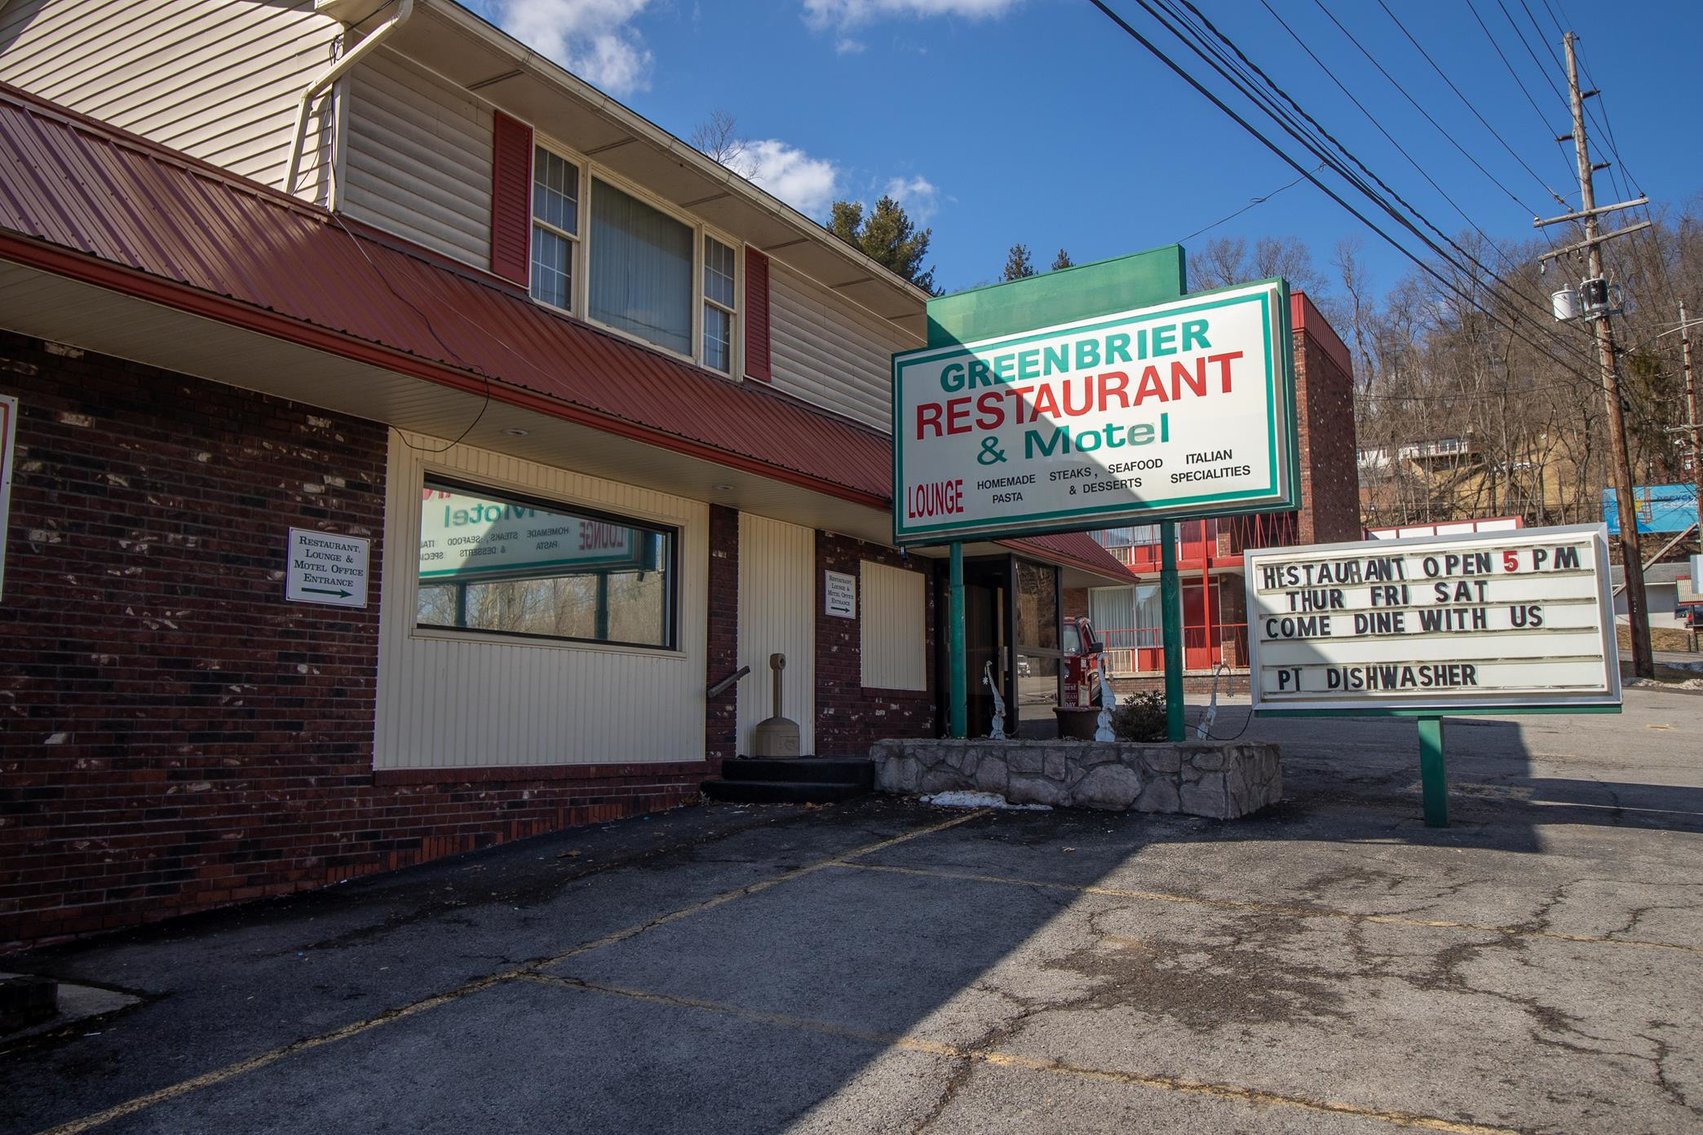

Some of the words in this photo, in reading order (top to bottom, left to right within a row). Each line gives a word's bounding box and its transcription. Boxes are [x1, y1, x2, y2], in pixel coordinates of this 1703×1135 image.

[940, 319, 1212, 392] GREENBRIER
[916, 351, 1244, 440] RESTAURANT
[976, 435, 1007, 466] &
[1025, 412, 1169, 460] Motel
[1108, 458, 1164, 474] SEAFOOD
[1185, 449, 1233, 464] ITALIAN
[977, 473, 1036, 490] HOMEMADE
[1170, 465, 1251, 484] SPECIALITIES
[1069, 485, 1077, 495] &
[1083, 477, 1142, 493] DESSERTS
[908, 479, 964, 519] LOUNGE
[992, 492, 1023, 504] PASTA
[305, 549, 341, 562] LOUNGE
[345, 555, 354, 564] &
[1423, 552, 1491, 578] OPEN
[1503, 550, 1519, 572] 5
[1532, 546, 1579, 570] PM
[294, 560, 327, 572] MOTEL
[331, 564, 363, 577] OFFICE
[303, 573, 354, 587] ENTRANCE
[1286, 588, 1344, 611] THUR
[1369, 584, 1408, 606] FRI
[1434, 580, 1487, 602] SAT
[1266, 615, 1331, 638] COME
[1354, 612, 1405, 634] DINE
[1419, 607, 1487, 631] WITH
[1510, 605, 1543, 627] US
[1278, 668, 1302, 691] PT
[1327, 664, 1477, 691] DISHWASHER
